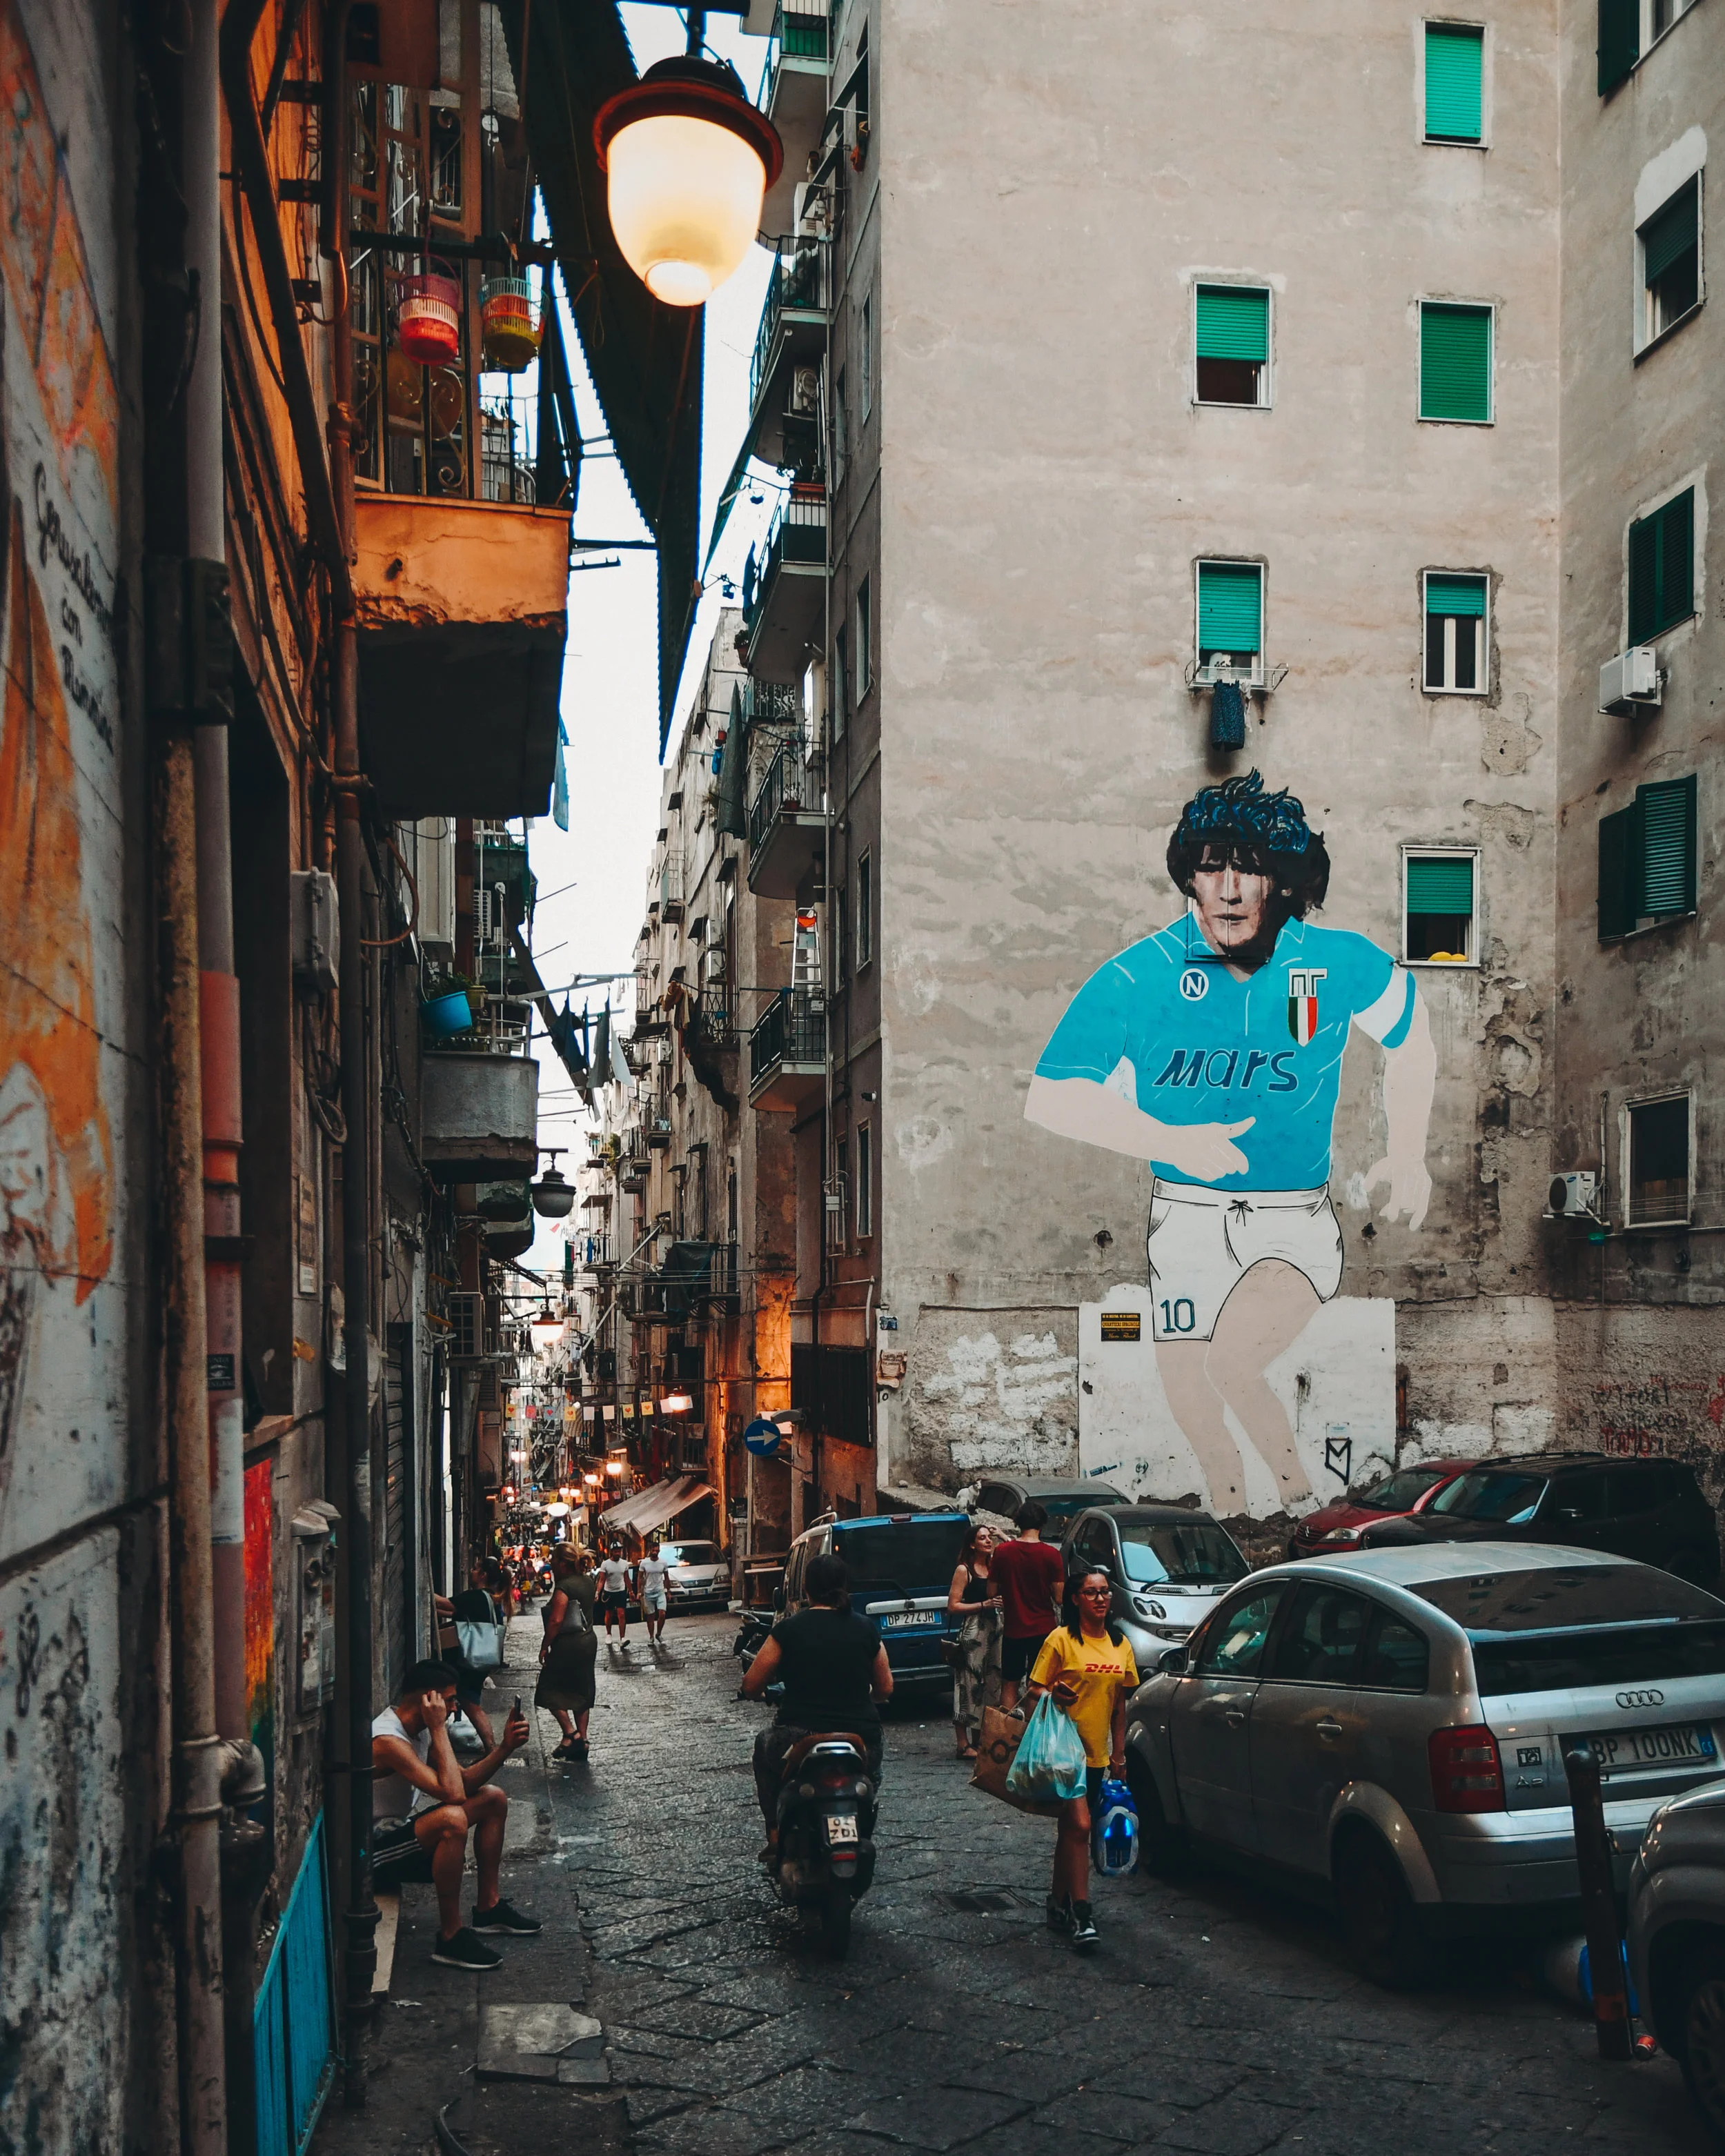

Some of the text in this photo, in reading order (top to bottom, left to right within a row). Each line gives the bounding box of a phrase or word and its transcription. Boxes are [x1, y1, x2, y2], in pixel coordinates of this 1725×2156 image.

[1160, 1298, 1196, 1334] 10
[888, 1614, 900, 1625] DP
[1084, 1663, 1123, 1674] DHL
[1591, 1737, 1618, 1765] BP
[1702, 1741, 1713, 1753] CS
